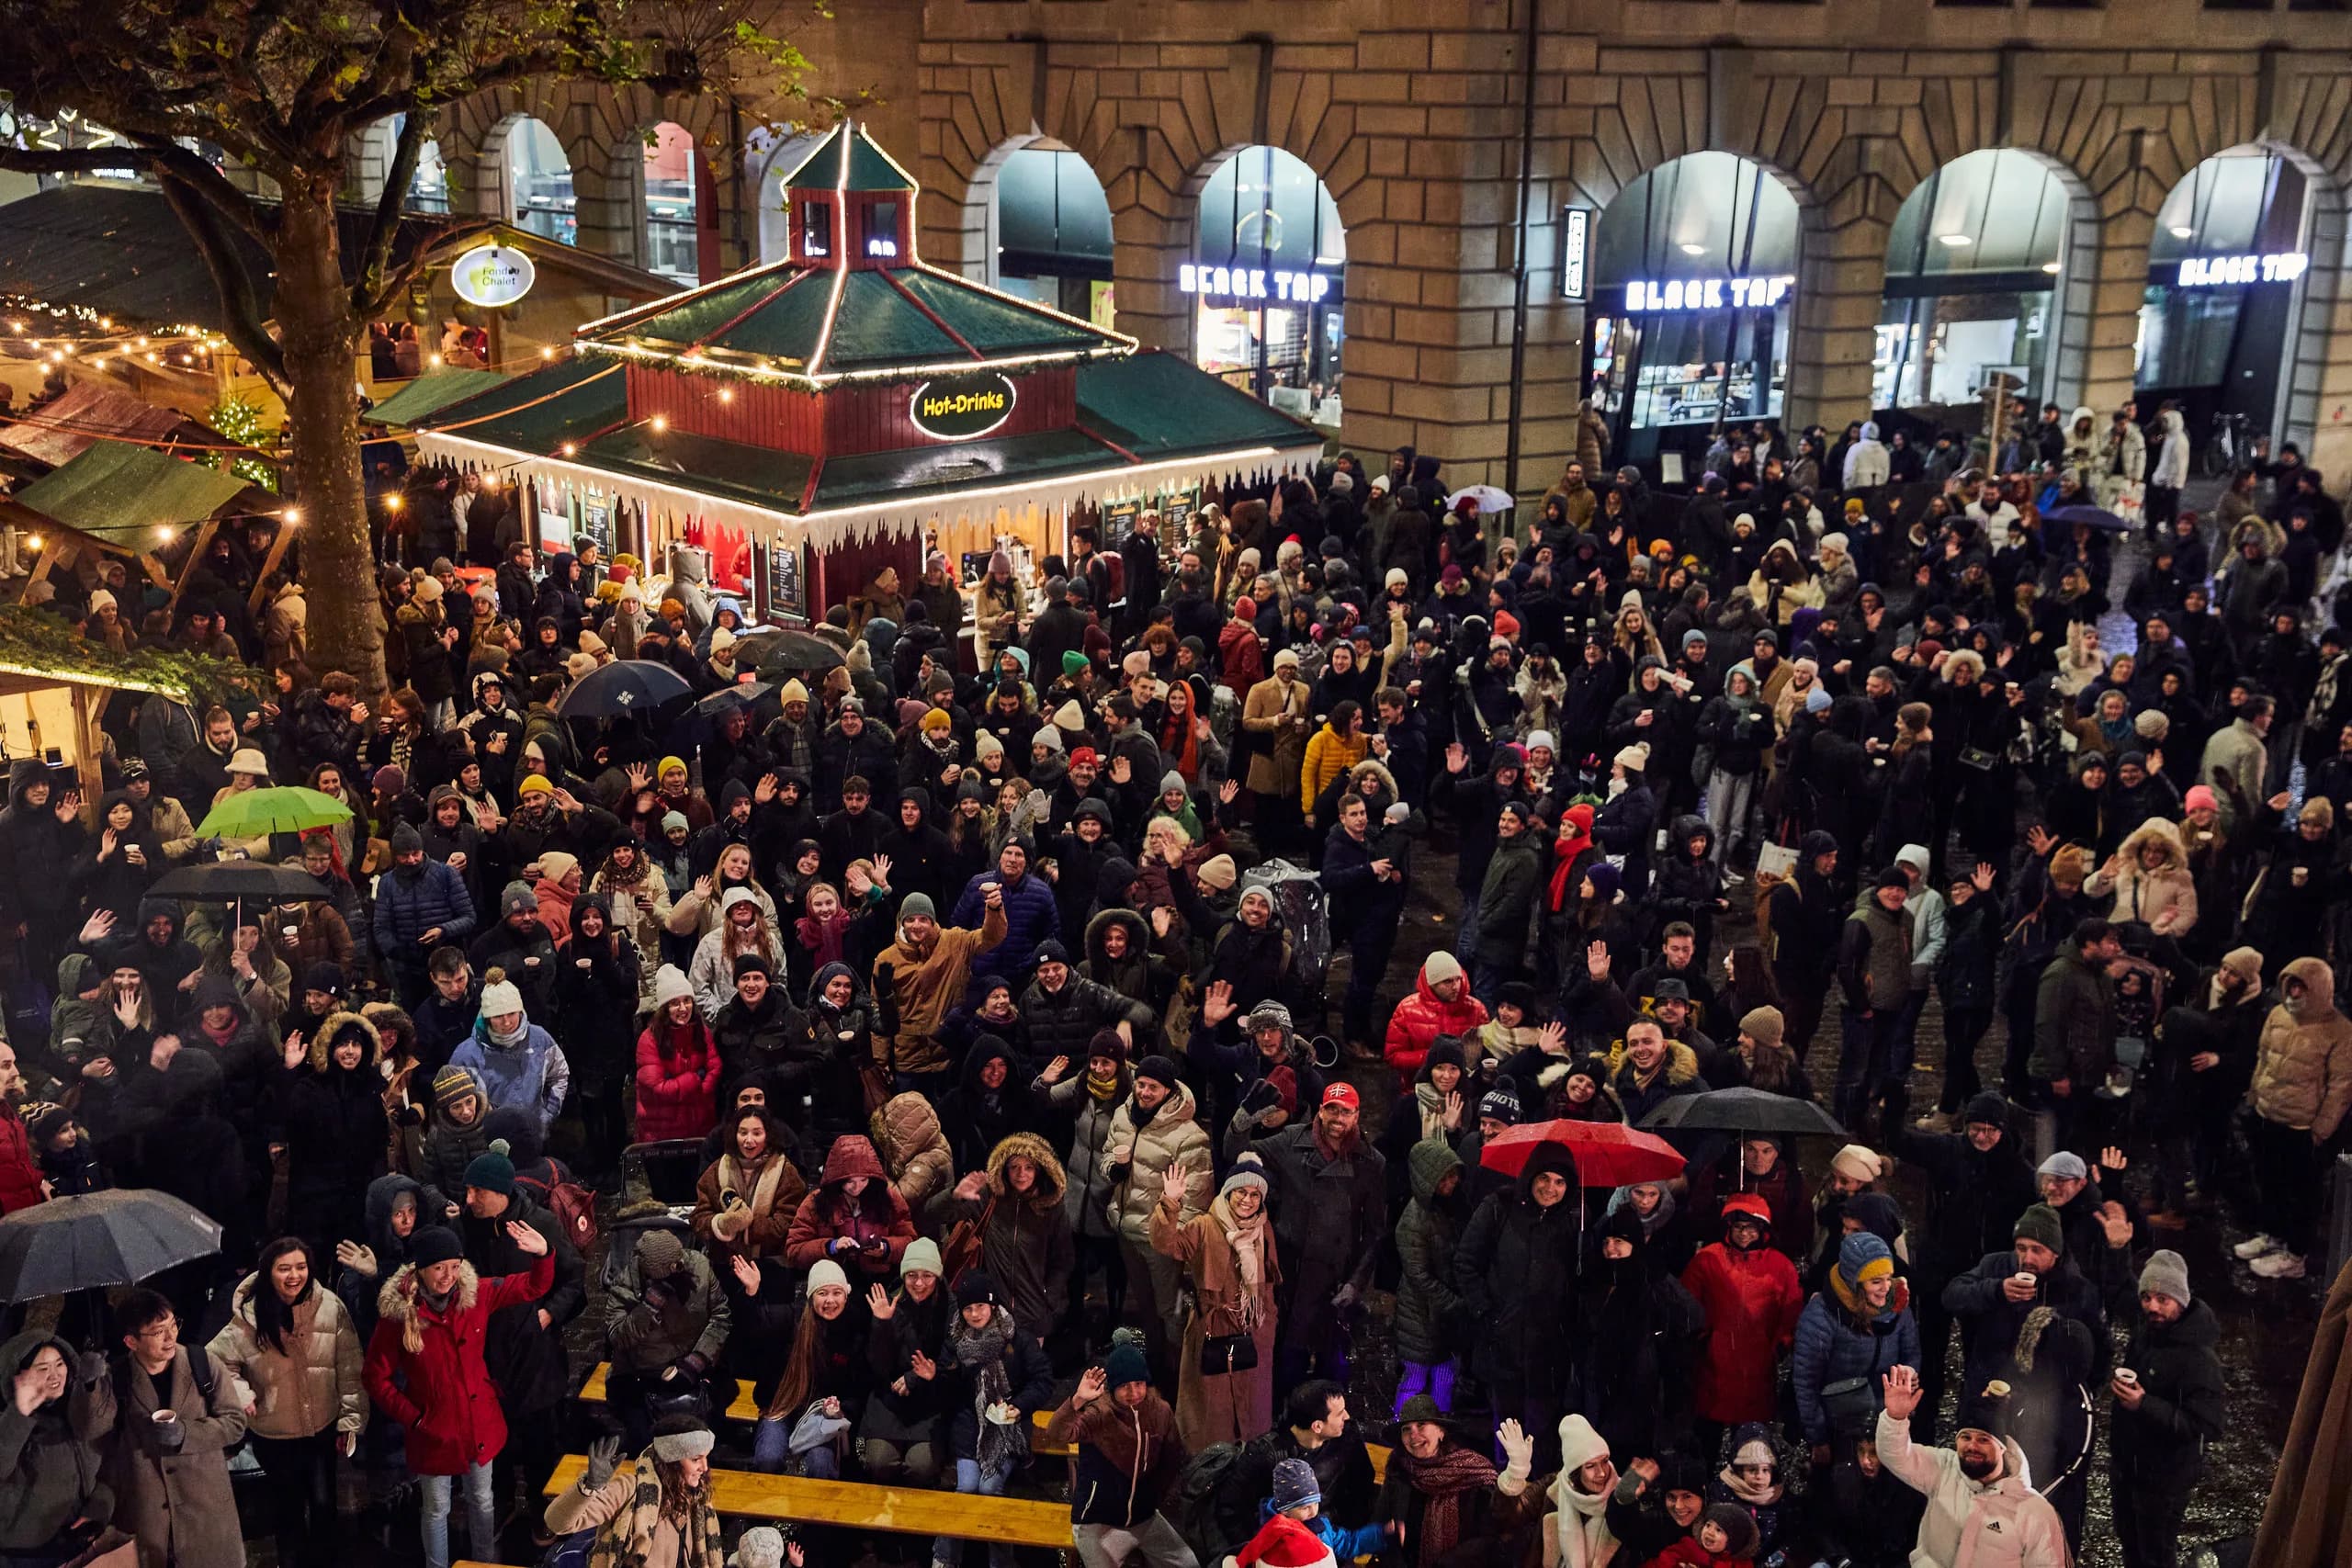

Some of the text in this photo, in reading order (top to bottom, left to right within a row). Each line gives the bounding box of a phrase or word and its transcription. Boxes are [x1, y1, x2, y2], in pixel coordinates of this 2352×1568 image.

[482, 276, 515, 286] Chalet
[1180, 265, 1329, 302] BLACK TAP
[2178, 255, 2258, 287] BLACK
[1625, 277, 1786, 310] BLACK TAP
[923, 390, 1004, 417] Hot-Drinks
[1482, 1091, 1520, 1111] RIOTS
